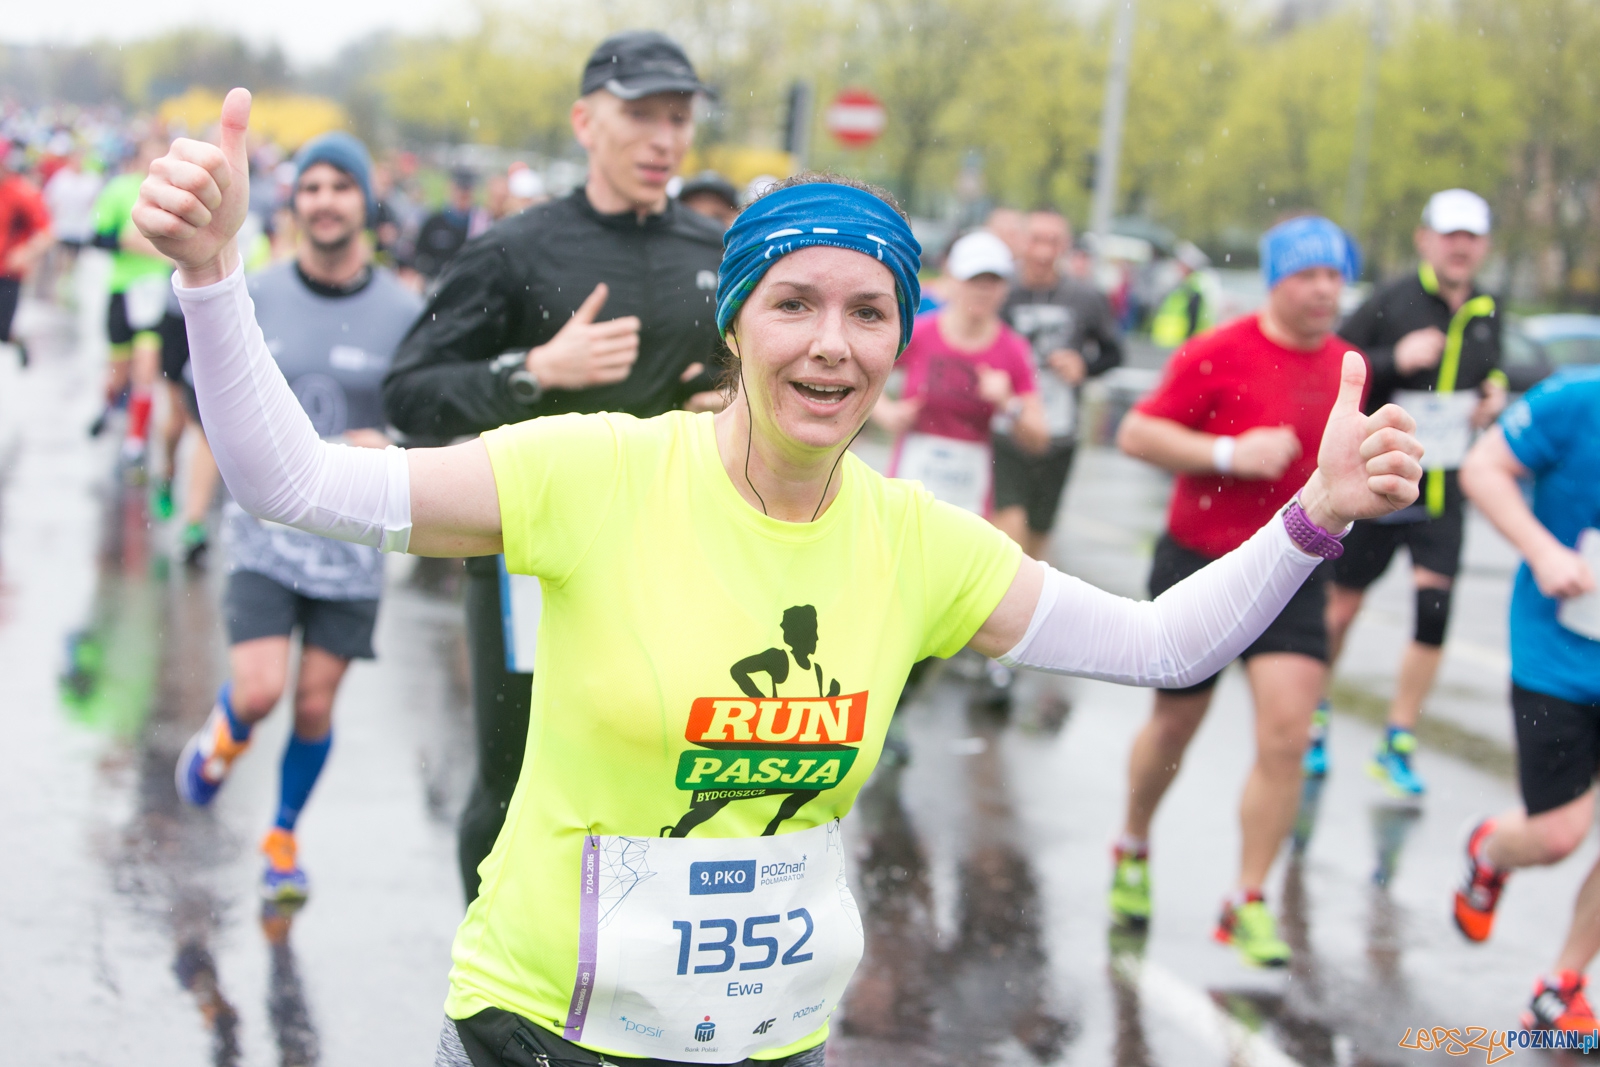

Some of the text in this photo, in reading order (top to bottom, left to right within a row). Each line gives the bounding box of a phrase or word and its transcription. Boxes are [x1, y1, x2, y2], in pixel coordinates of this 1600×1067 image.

[700, 698, 853, 743] RUN
[684, 757, 841, 784] PASJA
[696, 789, 767, 803] BYDGOSZCZ
[586, 853, 595, 895] 17.04.2016
[700, 869, 747, 887] 9. PKO
[672, 907, 815, 976] 1352
[581, 971, 590, 986] K39
[726, 981, 764, 998] Ewa
[624, 1020, 665, 1038] posir
